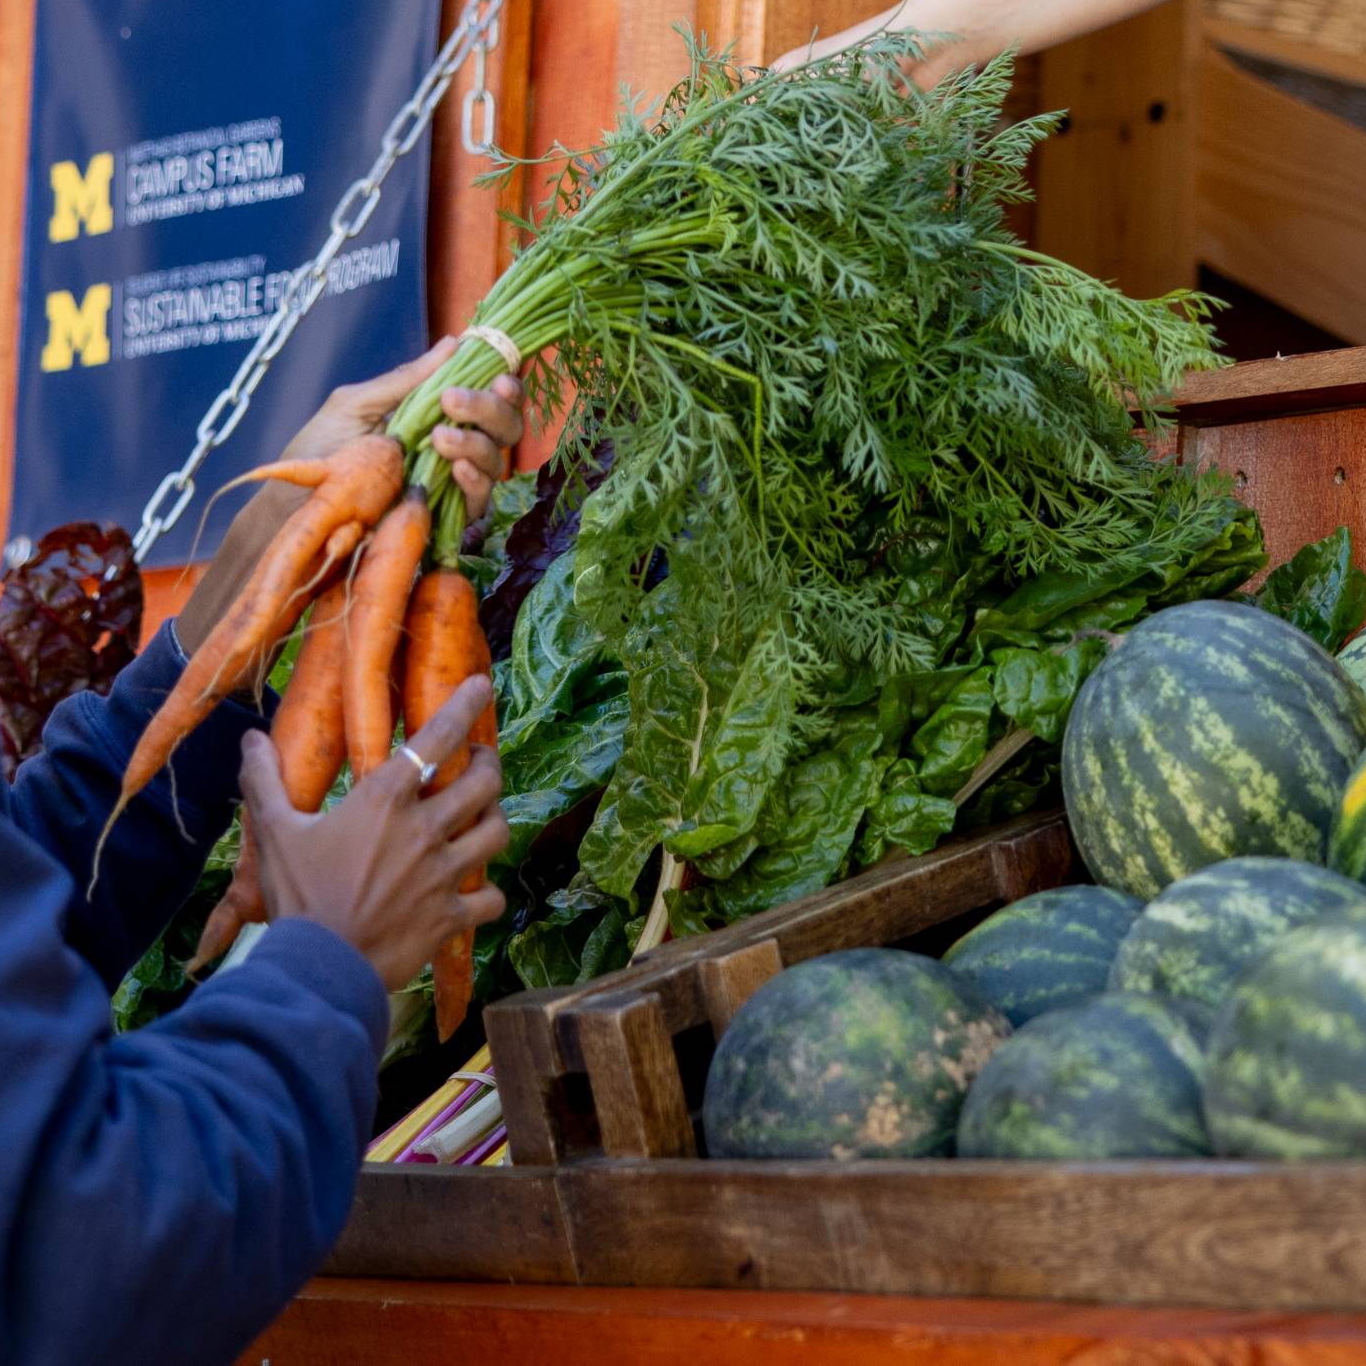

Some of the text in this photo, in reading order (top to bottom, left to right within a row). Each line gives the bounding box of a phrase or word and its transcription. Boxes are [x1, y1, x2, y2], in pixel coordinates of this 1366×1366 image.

[48, 151, 114, 244] M
[126, 149, 215, 205] CAMPUS
[216, 138, 284, 186] FARM
[41, 283, 112, 373] M
[123, 276, 264, 335] SUSTAINABLE
